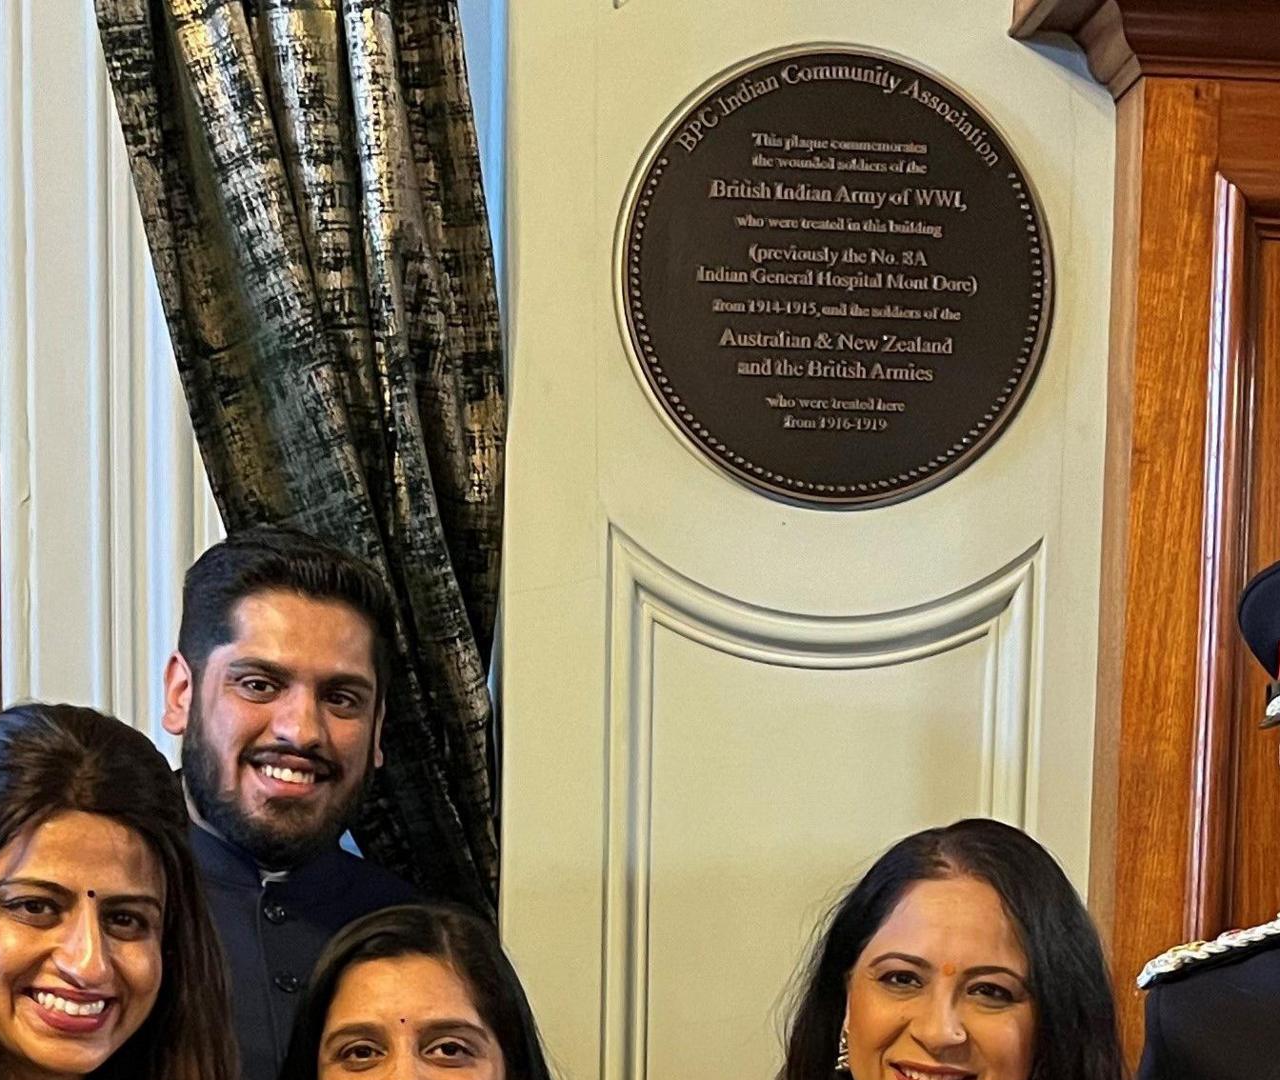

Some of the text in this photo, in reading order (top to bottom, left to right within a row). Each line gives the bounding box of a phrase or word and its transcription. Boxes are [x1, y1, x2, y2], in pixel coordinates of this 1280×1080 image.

[673, 63, 999, 168] BPC Indian Community Association
[751, 132, 928, 154] This plaque commemorates
[751, 153, 928, 175] the wounded soldiers of the
[708, 179, 772, 199] British
[774, 181, 832, 202] Indian
[835, 184, 887, 210] Army
[888, 187, 913, 206] of
[735, 214, 944, 239] who were treated in this building
[748, 242, 840, 268] (previously
[842, 247, 868, 264] the
[869, 247, 899, 265] No.
[696, 264, 978, 297] Indian General Hospital Mont Dore)
[712, 298, 961, 321] from 1914-1915, and the soldiers of the
[718, 327, 953, 354] Australian & New Zealand
[737, 358, 934, 382] and the British Armies
[765, 392, 906, 412] who were treated here
[783, 414, 888, 431] from 1916-1919
